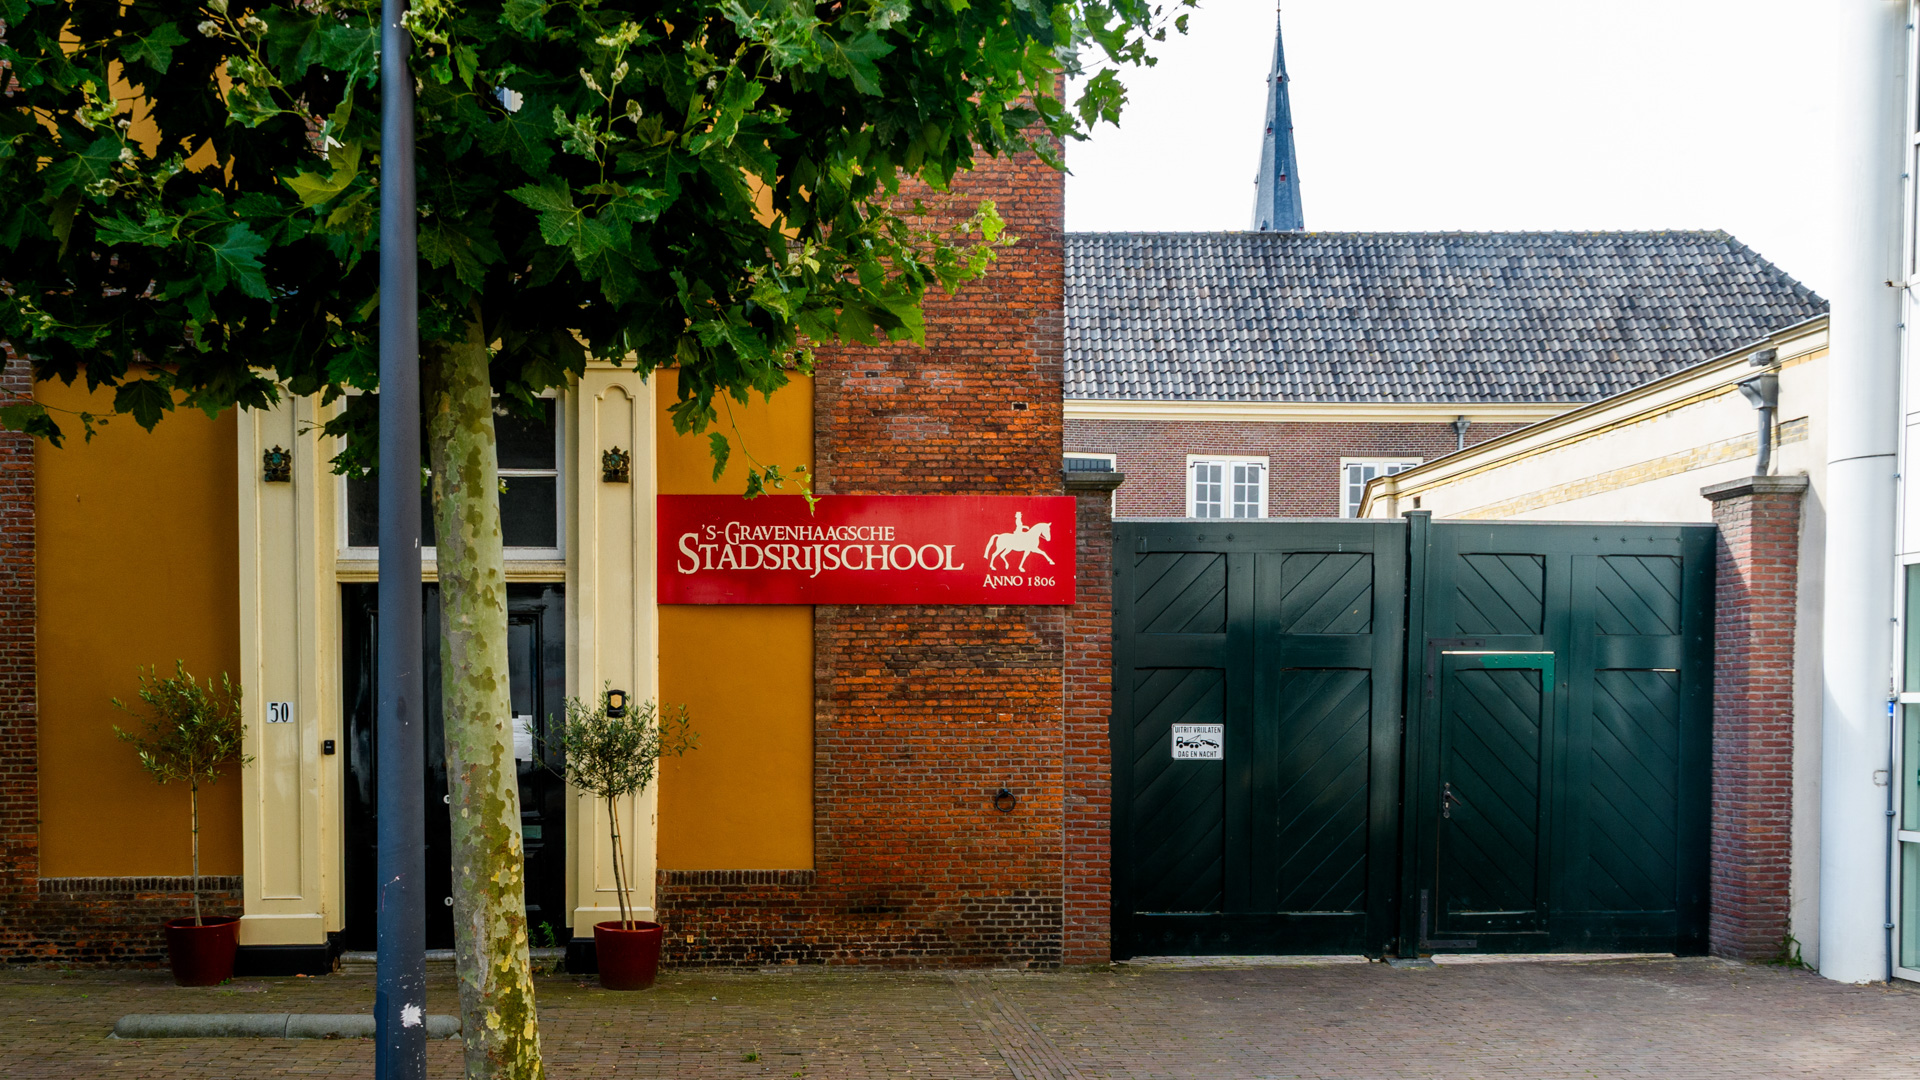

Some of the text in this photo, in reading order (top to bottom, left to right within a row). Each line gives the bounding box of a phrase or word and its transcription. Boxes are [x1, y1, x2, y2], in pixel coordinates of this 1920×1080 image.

[677, 532, 965, 579] STADSRIJSCHOOL
[982, 574, 1056, 590] ANNO 1806
[270, 702, 289, 723] 50
[1174, 726, 1221, 734] UITRIT VRIJLATEN
[1177, 750, 1217, 758] DAG EN NACHT
